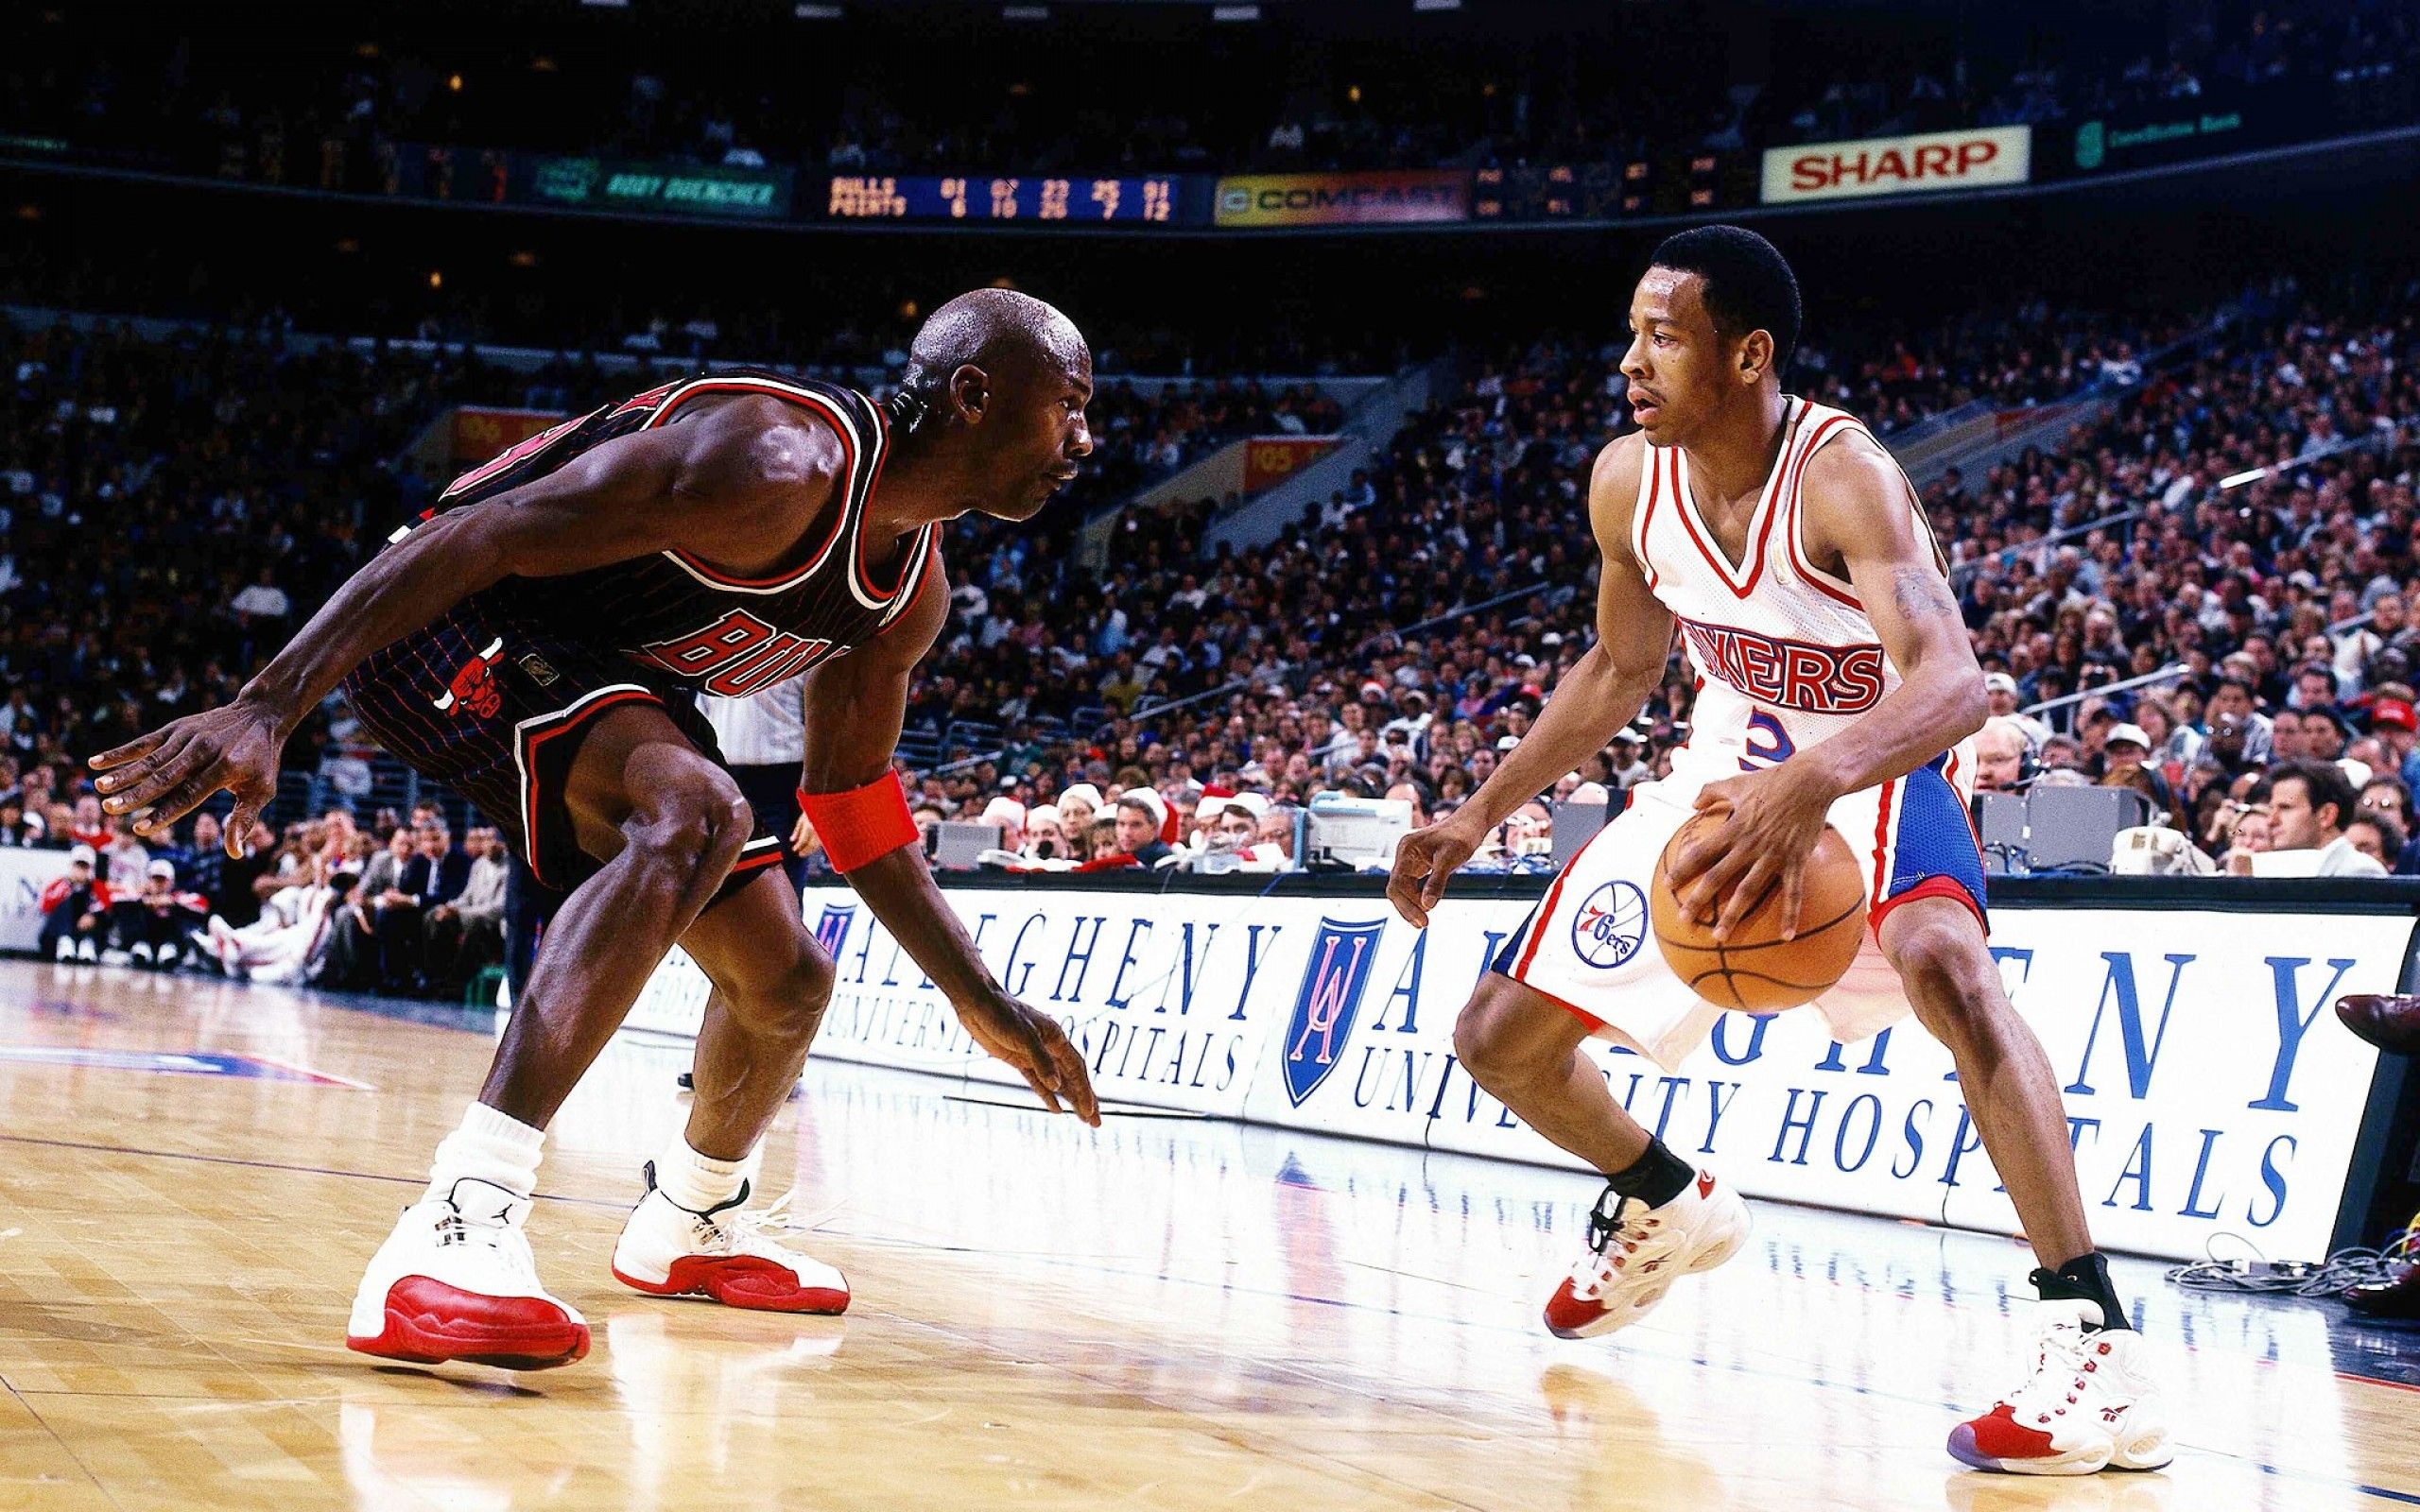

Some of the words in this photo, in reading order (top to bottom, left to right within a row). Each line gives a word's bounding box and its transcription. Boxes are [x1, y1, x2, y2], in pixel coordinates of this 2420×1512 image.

[829, 195, 908, 216] POINTS
[832, 177, 895, 196] BULLS
[1258, 184, 1455, 210] COMCAST
[1791, 140, 1999, 191] SHARP
[1685, 624, 1883, 711] XERS
[842, 913, 1282, 1021] ALGHENY
[827, 994, 975, 1055] UNIVERSI
[1059, 1015, 1243, 1091] OSPITALS
[1372, 927, 2357, 1112] ALGNY
[1354, 1046, 1741, 1154] UNIITY
[1767, 1088, 2298, 1228] HOSPTALS
